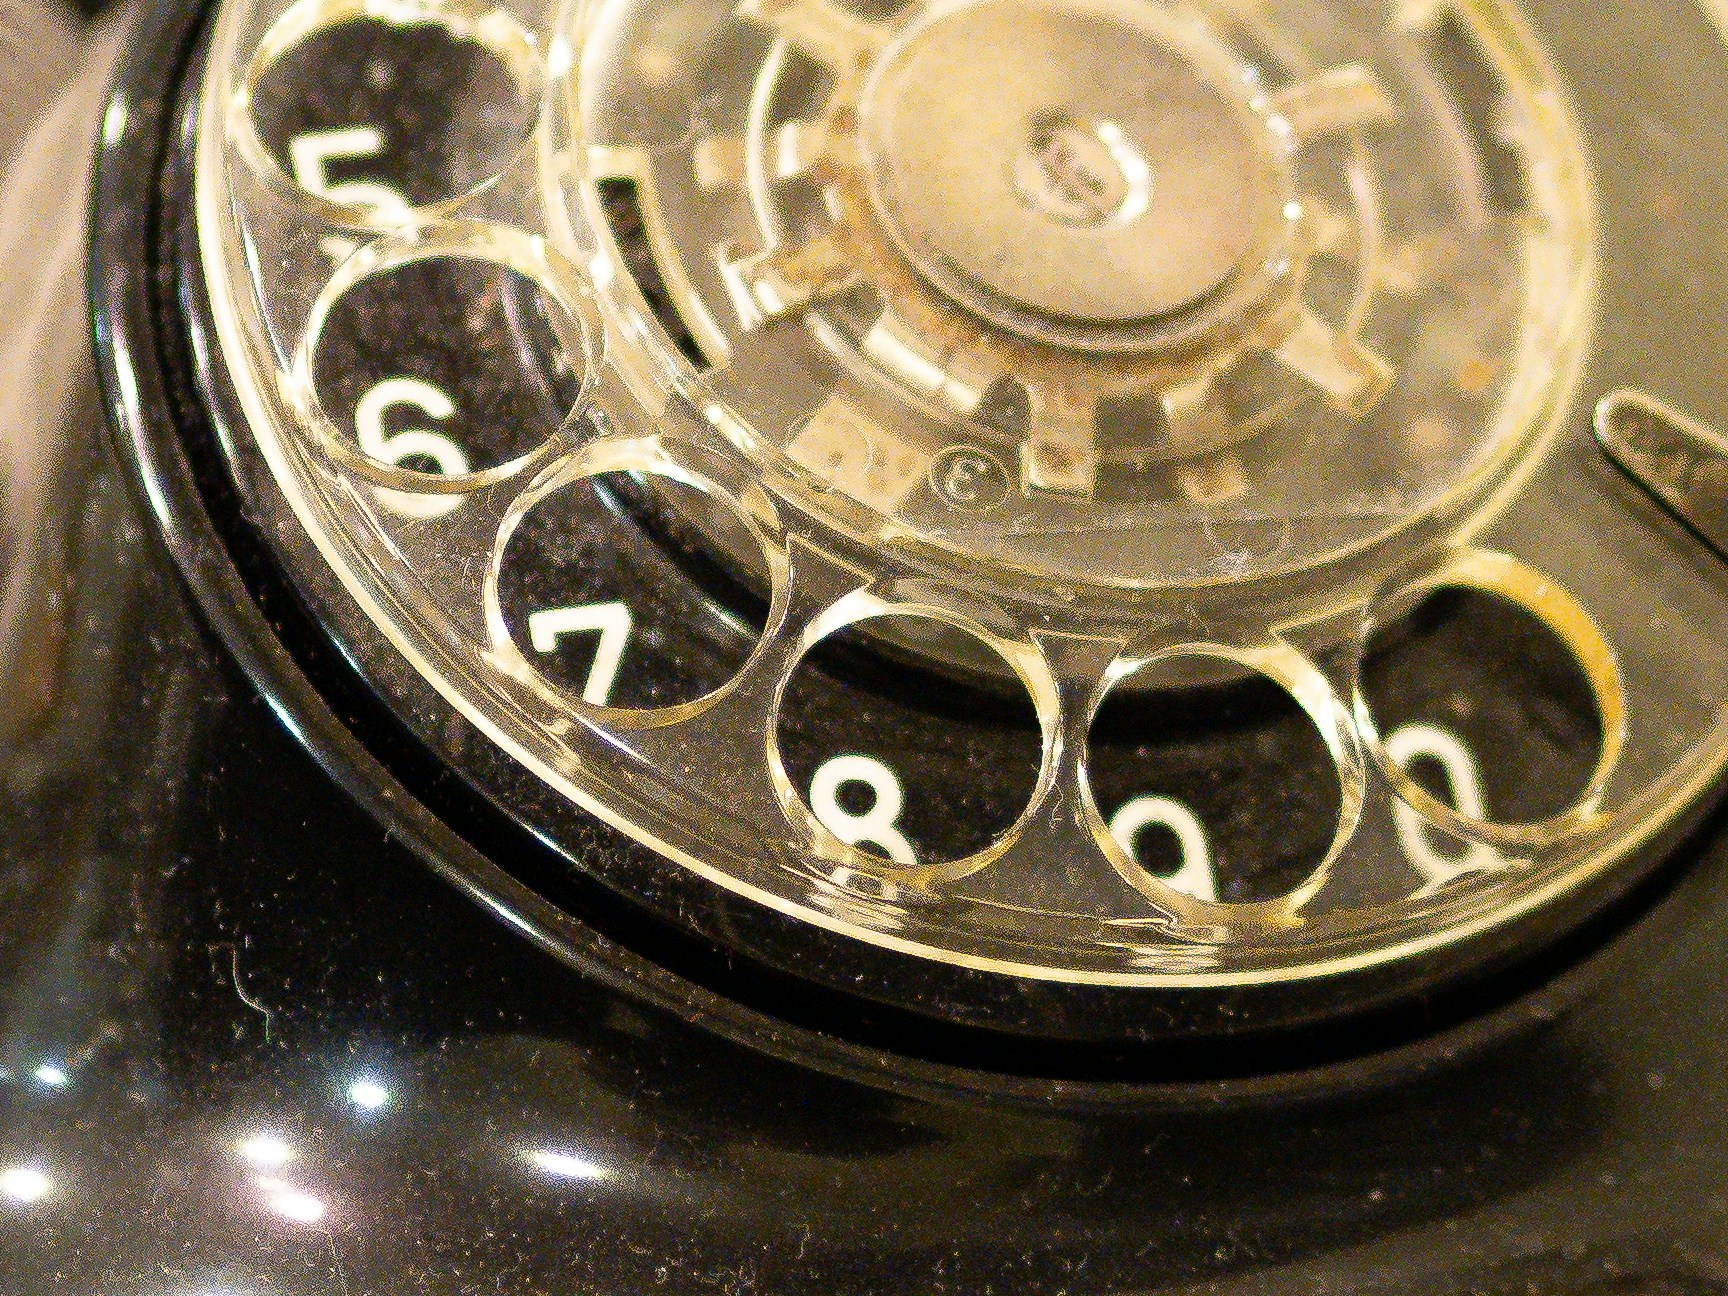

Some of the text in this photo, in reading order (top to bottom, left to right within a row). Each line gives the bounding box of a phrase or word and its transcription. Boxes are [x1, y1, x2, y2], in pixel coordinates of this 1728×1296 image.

[290, 127, 418, 262] 5
[355, 376, 472, 520] 6
[527, 602, 636, 708] 7
[808, 753, 918, 894] 8
[1108, 794, 1218, 904] 9
